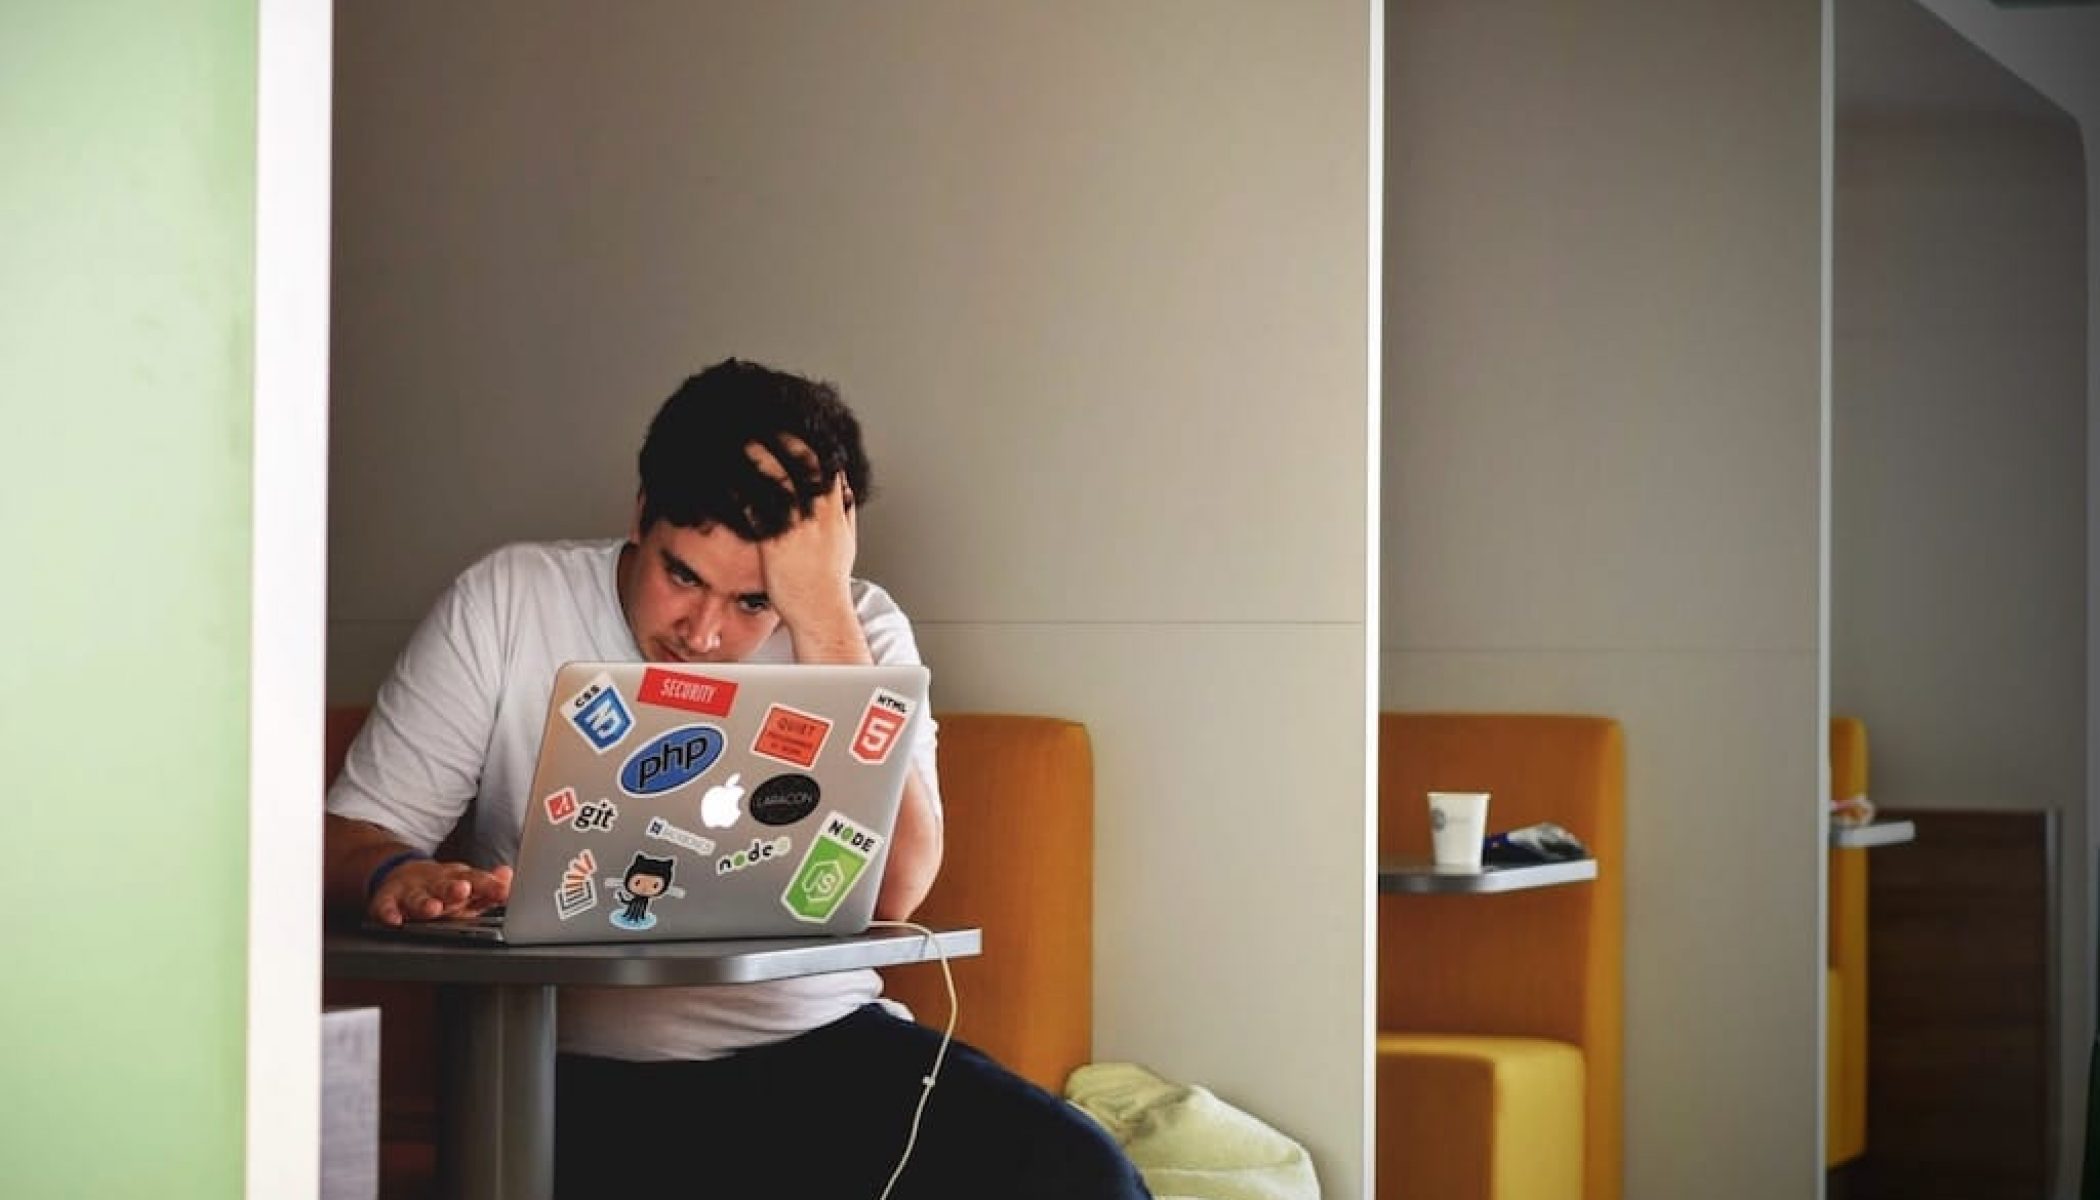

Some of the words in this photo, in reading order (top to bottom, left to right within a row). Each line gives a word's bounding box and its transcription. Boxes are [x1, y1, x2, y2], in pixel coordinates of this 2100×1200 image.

[574, 684, 600, 708] CSS
[659, 678, 718, 704] SECURITY
[877, 694, 907, 713] HTML
[861, 716, 897, 752] 5
[638, 737, 709, 790] php
[575, 801, 616, 829] git
[828, 819, 876, 852] NODE
